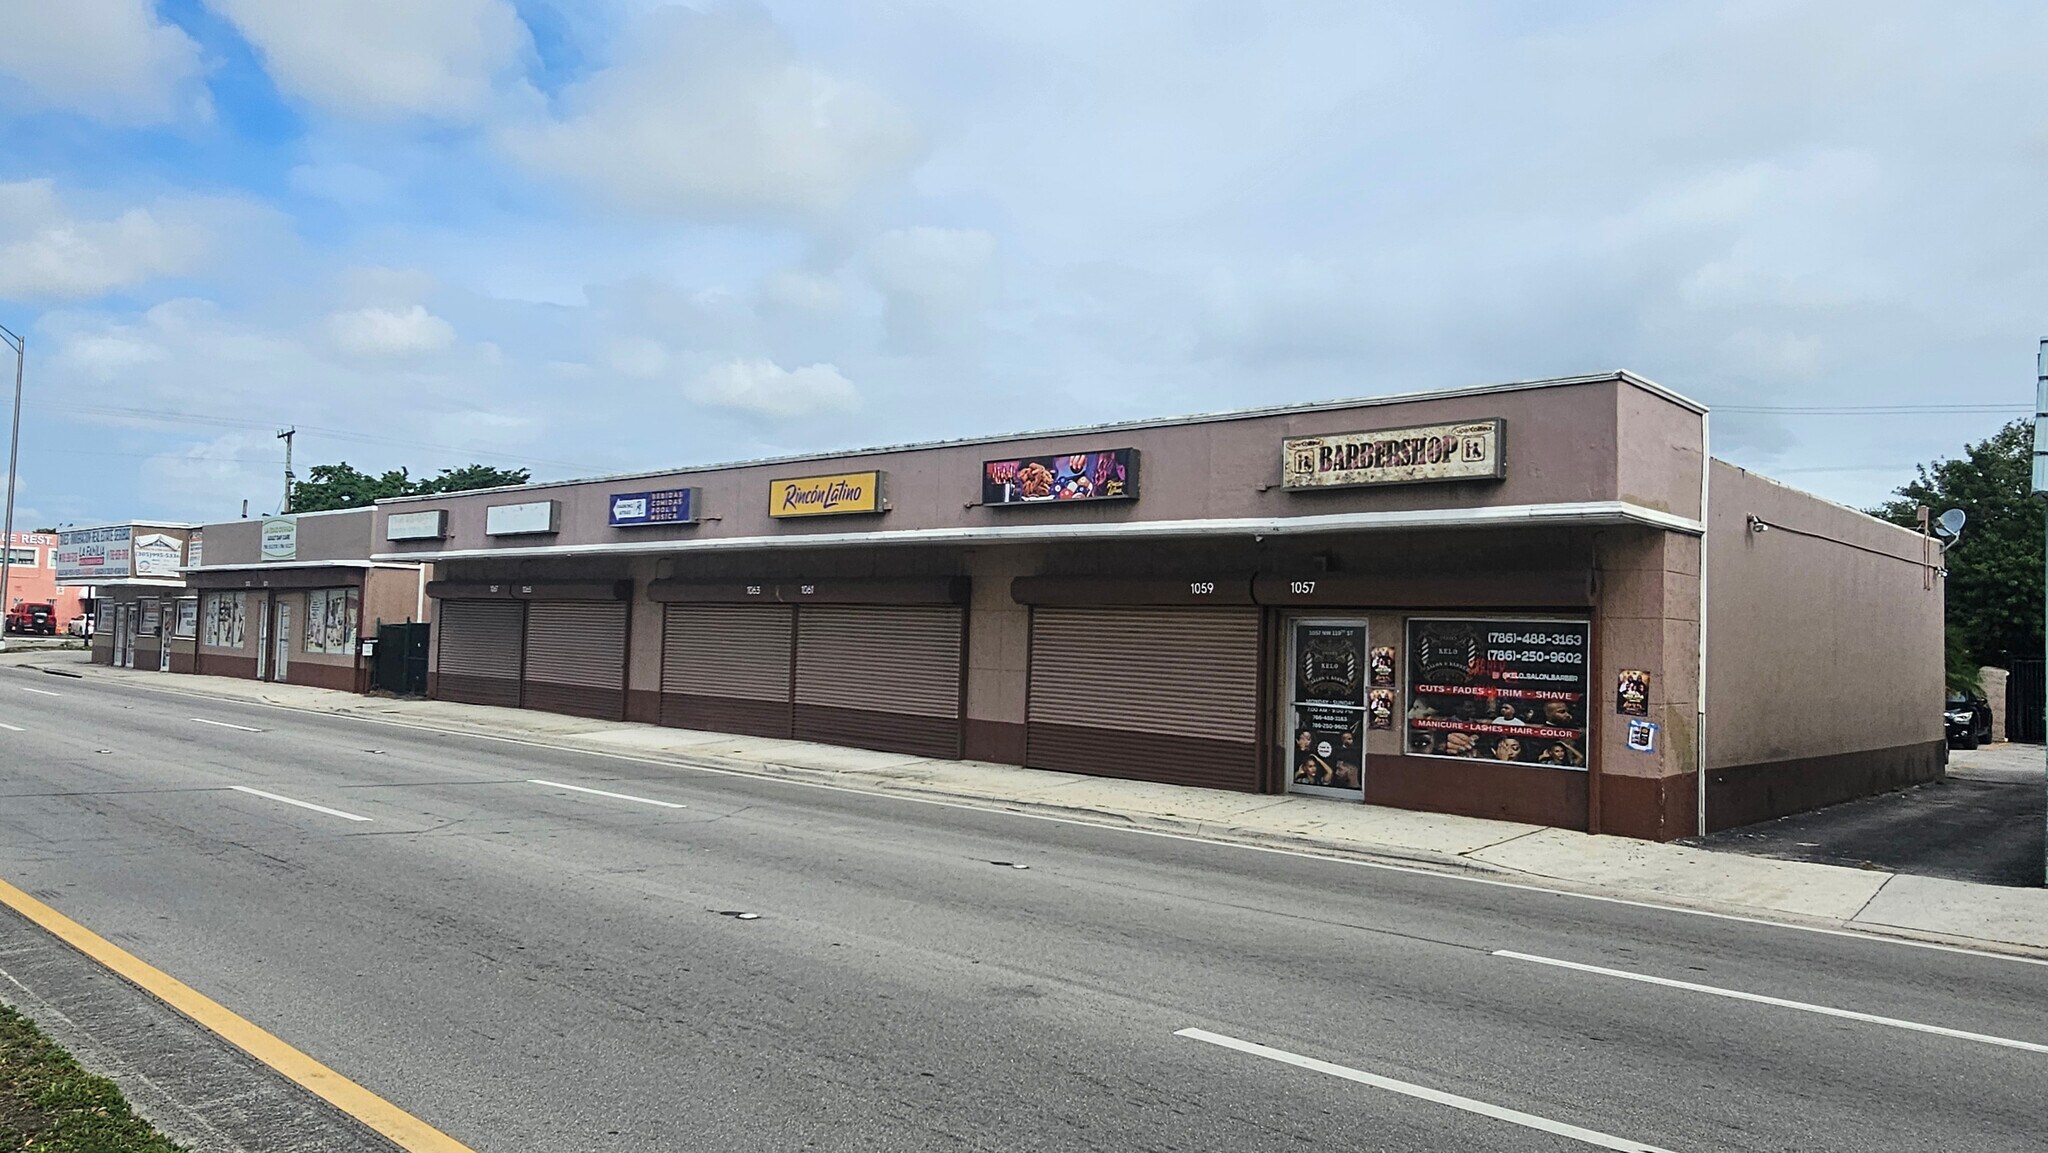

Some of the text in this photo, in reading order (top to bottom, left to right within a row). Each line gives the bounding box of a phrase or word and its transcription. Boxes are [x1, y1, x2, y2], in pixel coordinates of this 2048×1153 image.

[1318, 435, 1458, 472] BARBERSHOP
[651, 491, 683, 499] BEBIDAS
[651, 498, 682, 506] COMIDAS
[783, 480, 862, 511] Rincón Latino
[1190, 582, 1214, 594] 1059
[1290, 581, 1316, 594] 1057
[1488, 632, 1582, 646] (786)-488-3163
[1487, 650, 1582, 664] (786)-250-9602
[1418, 684, 1445, 693] CUTS
[1452, 686, 1484, 695] FADES
[1497, 689, 1522, 697] TRIM
[1535, 690, 1572, 700] SHAVE
[1418, 720, 1463, 730] MANICURE
[1470, 724, 1503, 733] LASHES
[1510, 727, 1533, 735] HAIR
[1540, 729, 1573, 738] COLOR
